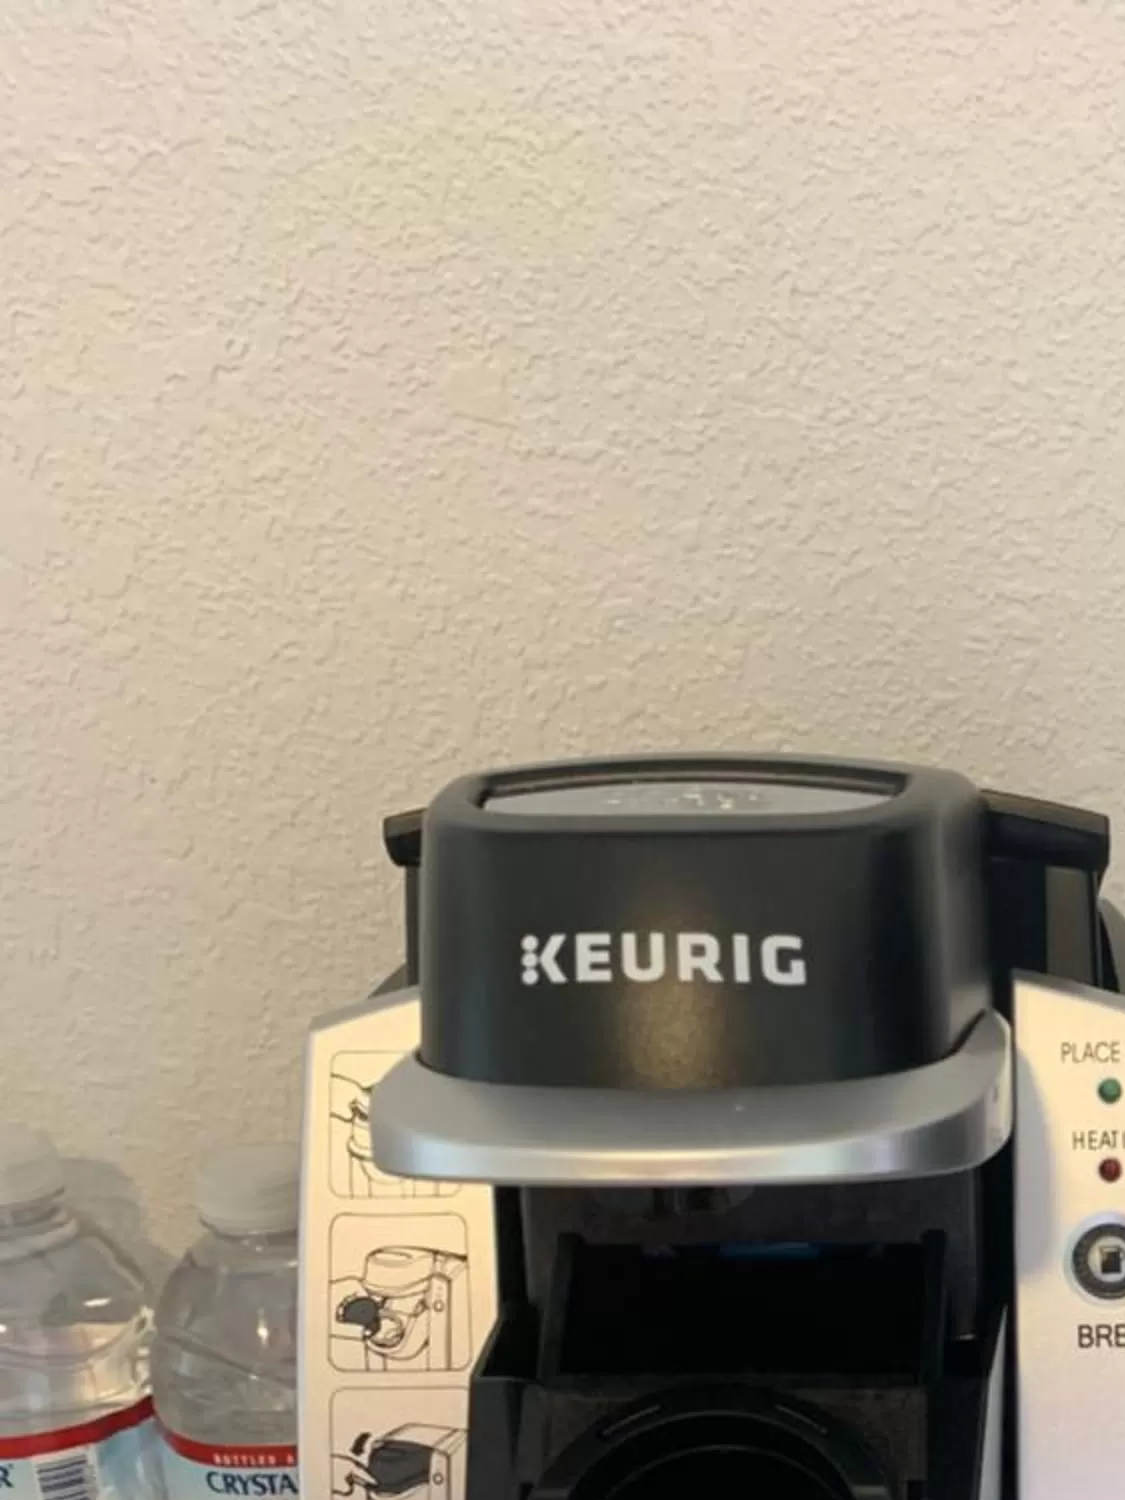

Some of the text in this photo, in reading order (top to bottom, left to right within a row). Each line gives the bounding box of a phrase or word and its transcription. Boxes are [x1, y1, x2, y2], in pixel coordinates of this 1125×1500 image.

[521, 931, 807, 986] KEURIG
[1061, 1042, 1120, 1063] PLACE
[206, 1470, 298, 1496] CRYSTA
